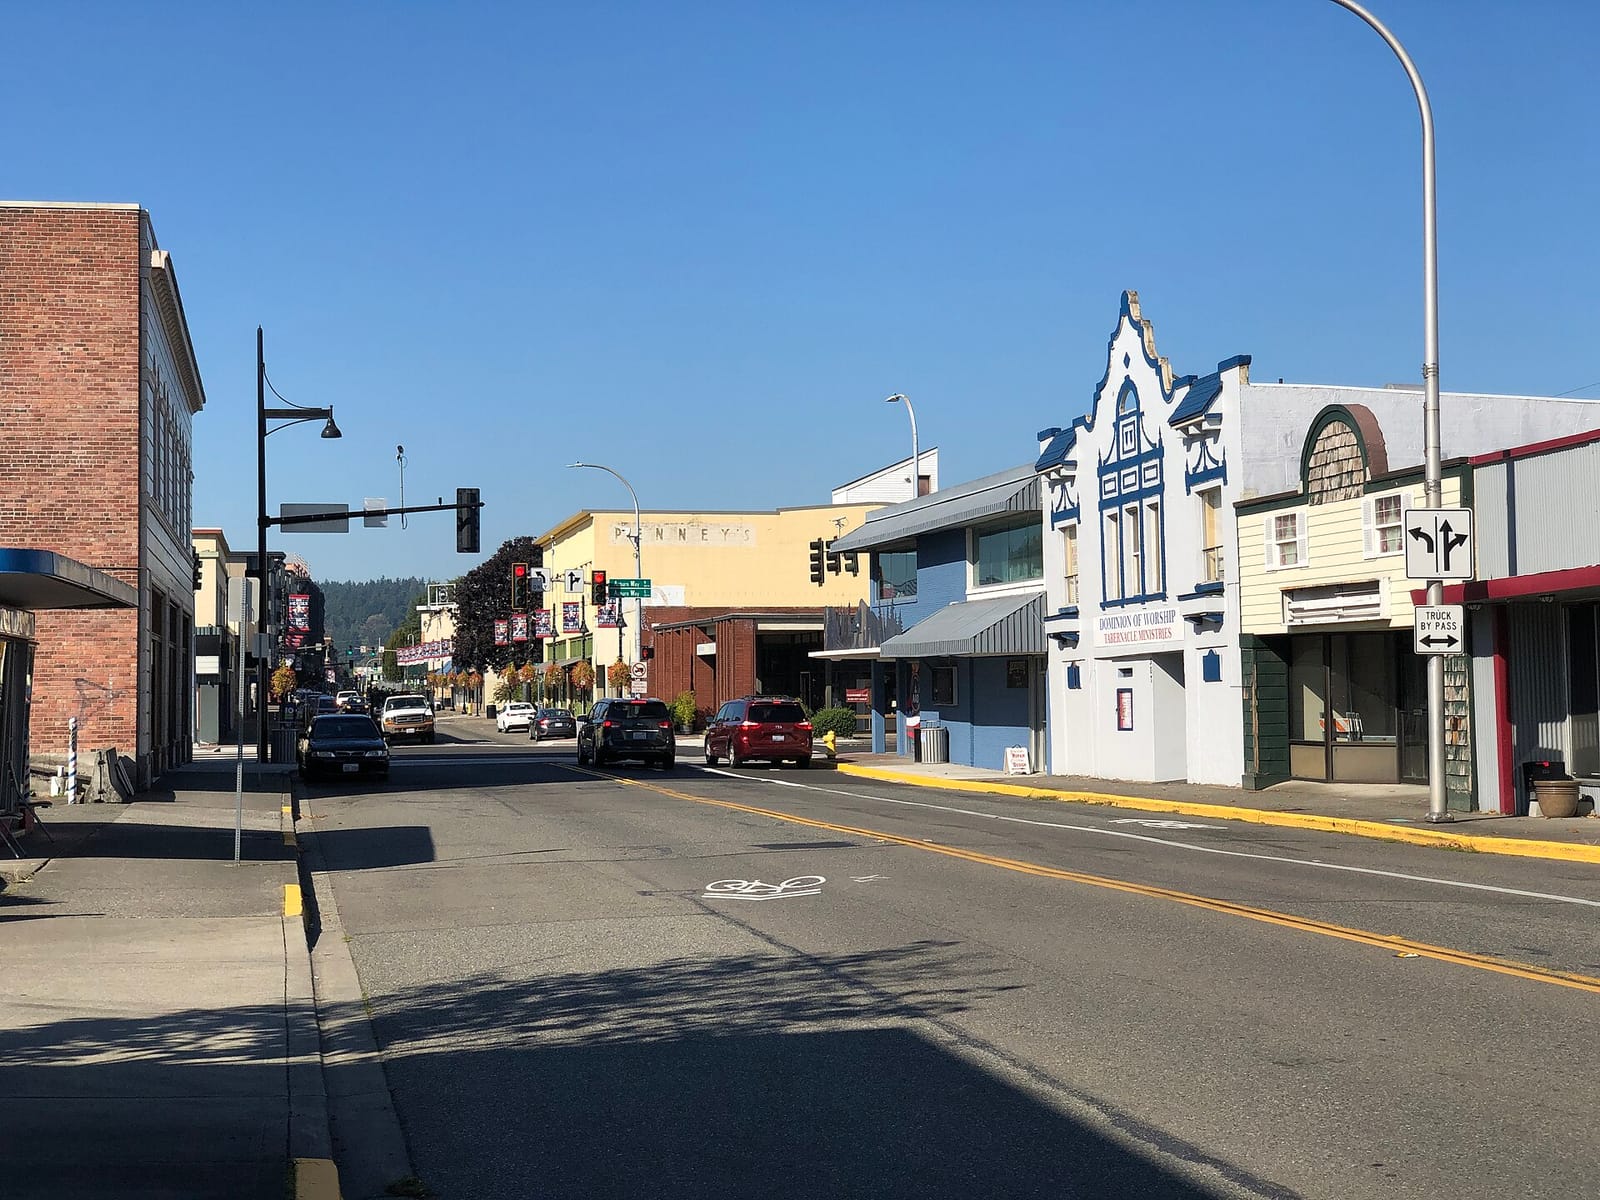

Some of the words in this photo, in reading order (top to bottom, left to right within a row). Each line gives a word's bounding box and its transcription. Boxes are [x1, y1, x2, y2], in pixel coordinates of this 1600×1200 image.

[1099, 615, 1132, 631] DOMINION
[1133, 613, 1141, 627] OF
[1143, 609, 1176, 626] WORSHIP
[1425, 611, 1452, 620] TRUCK
[1420, 621, 1431, 630] BY
[1435, 621, 1457, 630] PASS
[1104, 630, 1137, 644] TABERNACLE
[1138, 627, 1172, 641] MINISTRIES
